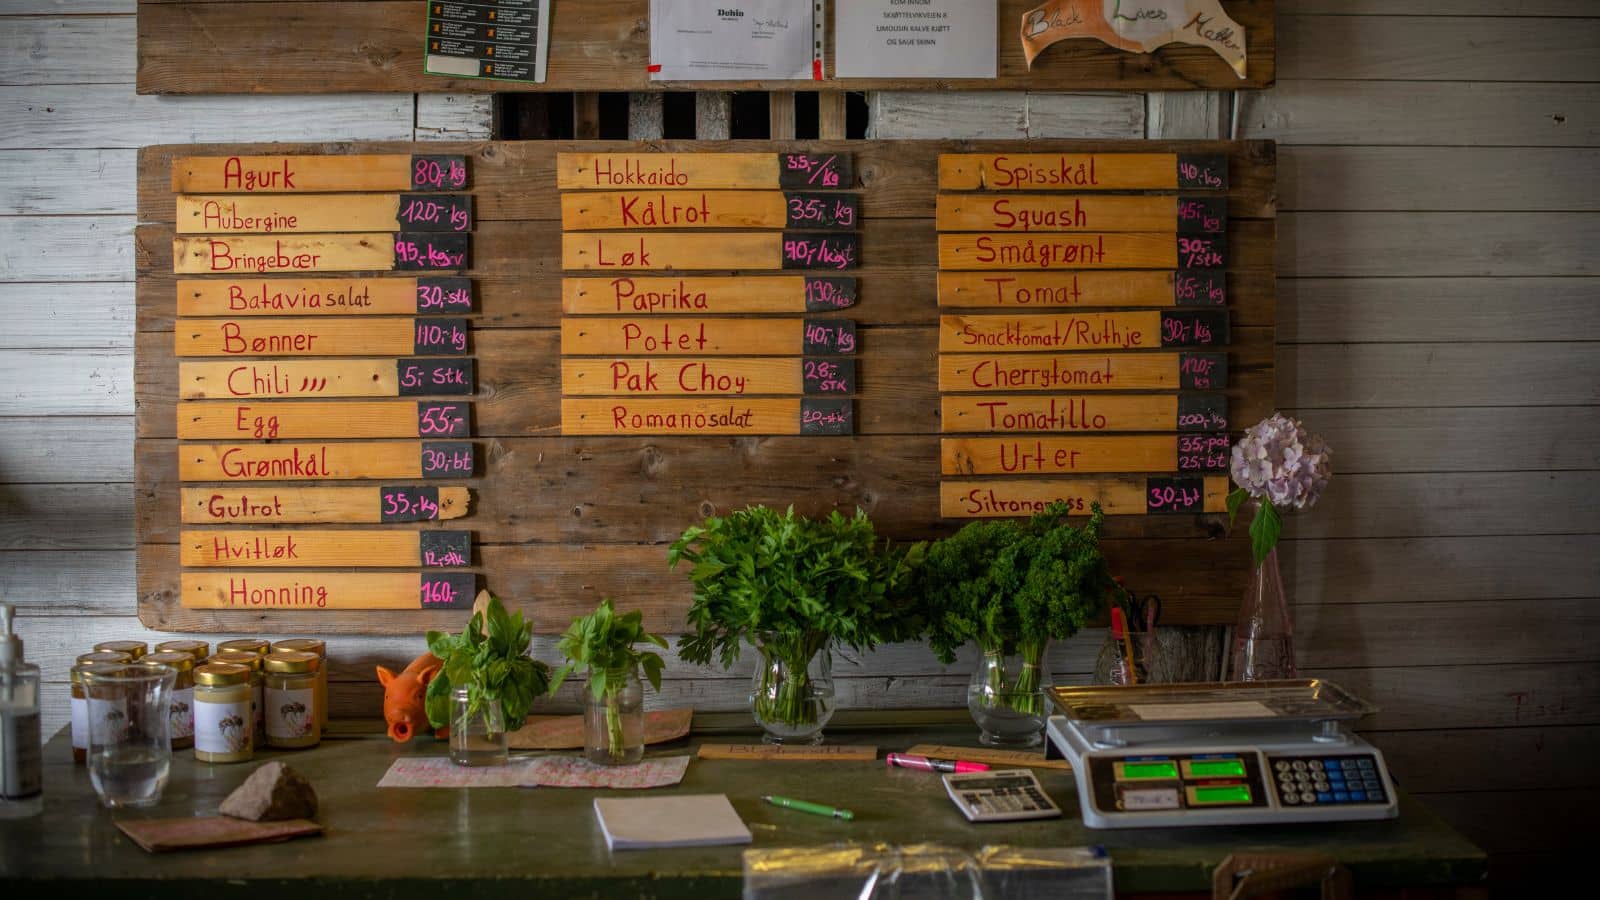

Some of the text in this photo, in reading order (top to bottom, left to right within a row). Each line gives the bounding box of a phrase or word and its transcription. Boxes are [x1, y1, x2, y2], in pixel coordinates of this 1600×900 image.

[1028, 9, 1083, 41] Black
[1113, 0, 1168, 21] Lives
[886, 38, 936, 46] OG SAUE SKINN
[223, 157, 296, 191] Agurk
[449, 160, 466, 186] kg
[595, 158, 689, 186] Hokkaido
[994, 156, 1098, 188] Spisskål
[204, 200, 298, 232] Aubergine
[450, 204, 468, 231] kg
[620, 193, 711, 226] Kålrot
[833, 199, 853, 225] kg
[993, 198, 1087, 231] Squash
[1202, 215, 1220, 232] kg
[210, 240, 321, 272] Bringebær
[598, 237, 650, 267] Løk
[975, 235, 1107, 267] Smågrønt
[610, 278, 708, 313] Paprika
[983, 275, 1082, 305] Tomat
[1208, 279, 1224, 305] kg
[221, 322, 318, 353] Bønner
[451, 325, 466, 351] kg
[622, 322, 708, 351] Potet
[837, 327, 855, 352] kg
[963, 318, 1141, 349] Snacktomat/Ruthje
[1193, 318, 1213, 343] kg
[227, 365, 289, 396] Chili
[610, 360, 658, 391] Pak
[678, 361, 746, 393] Choy
[972, 358, 1114, 389] Cherrytomat
[237, 406, 464, 438] Egg 55,-
[976, 399, 1107, 429] Tomatillo
[221, 446, 330, 478] Grønnkål
[1000, 441, 1081, 473] Urter
[208, 494, 282, 517] Gulrot
[213, 535, 299, 560] Hvitløk
[229, 578, 328, 608] Honning
